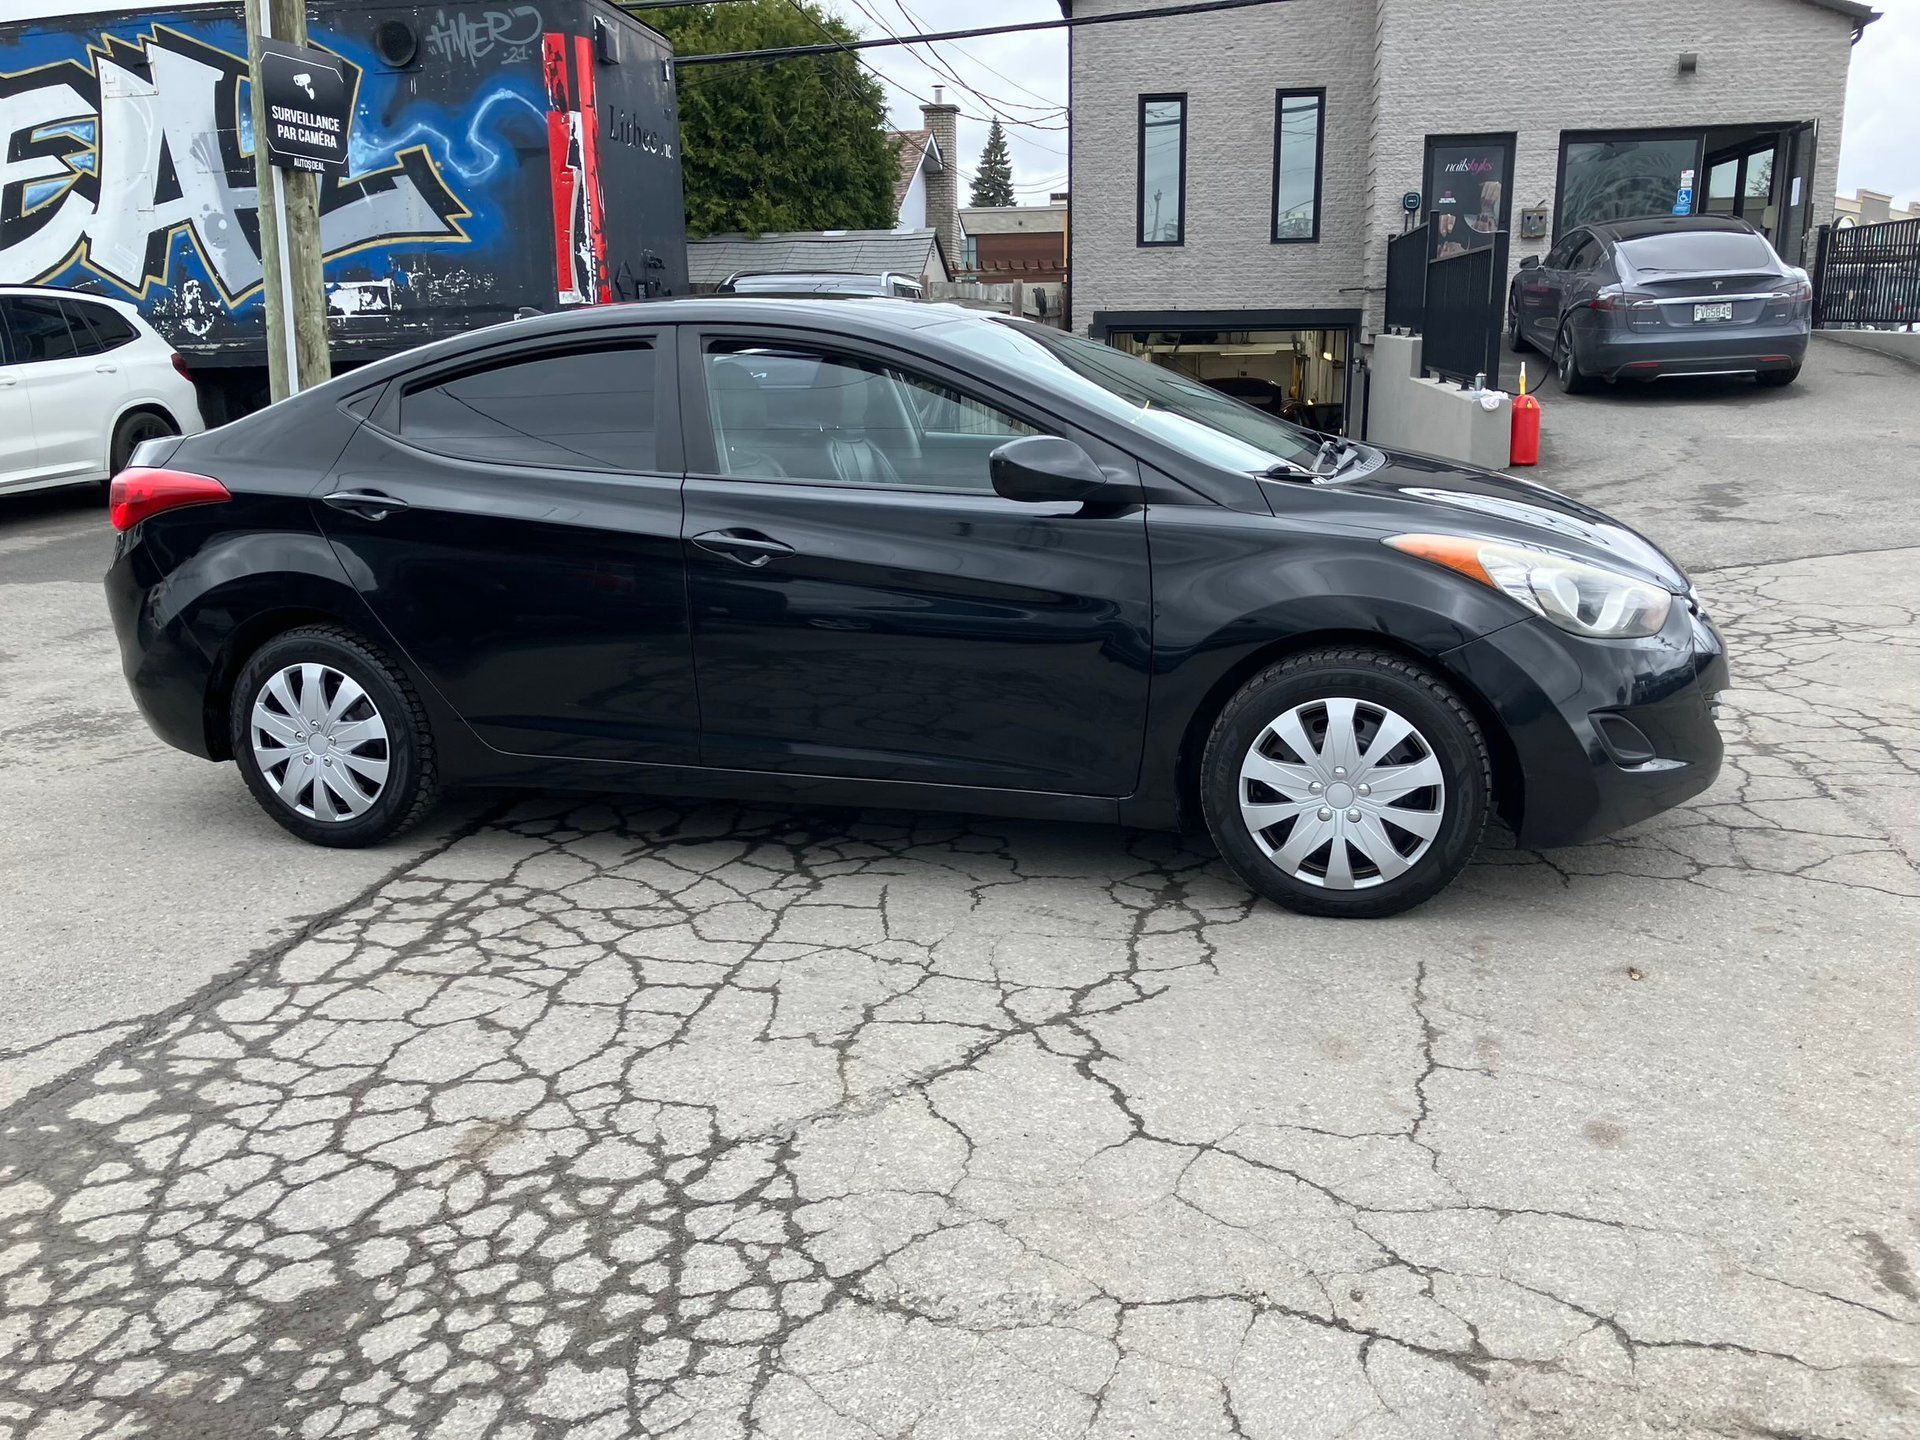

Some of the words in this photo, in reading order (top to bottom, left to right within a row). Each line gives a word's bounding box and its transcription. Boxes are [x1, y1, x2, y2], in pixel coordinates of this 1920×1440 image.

[271, 105, 340, 132] SURVEILLANCE
[277, 124, 297, 140] PAR
[298, 128, 338, 149] CAMÉRA
